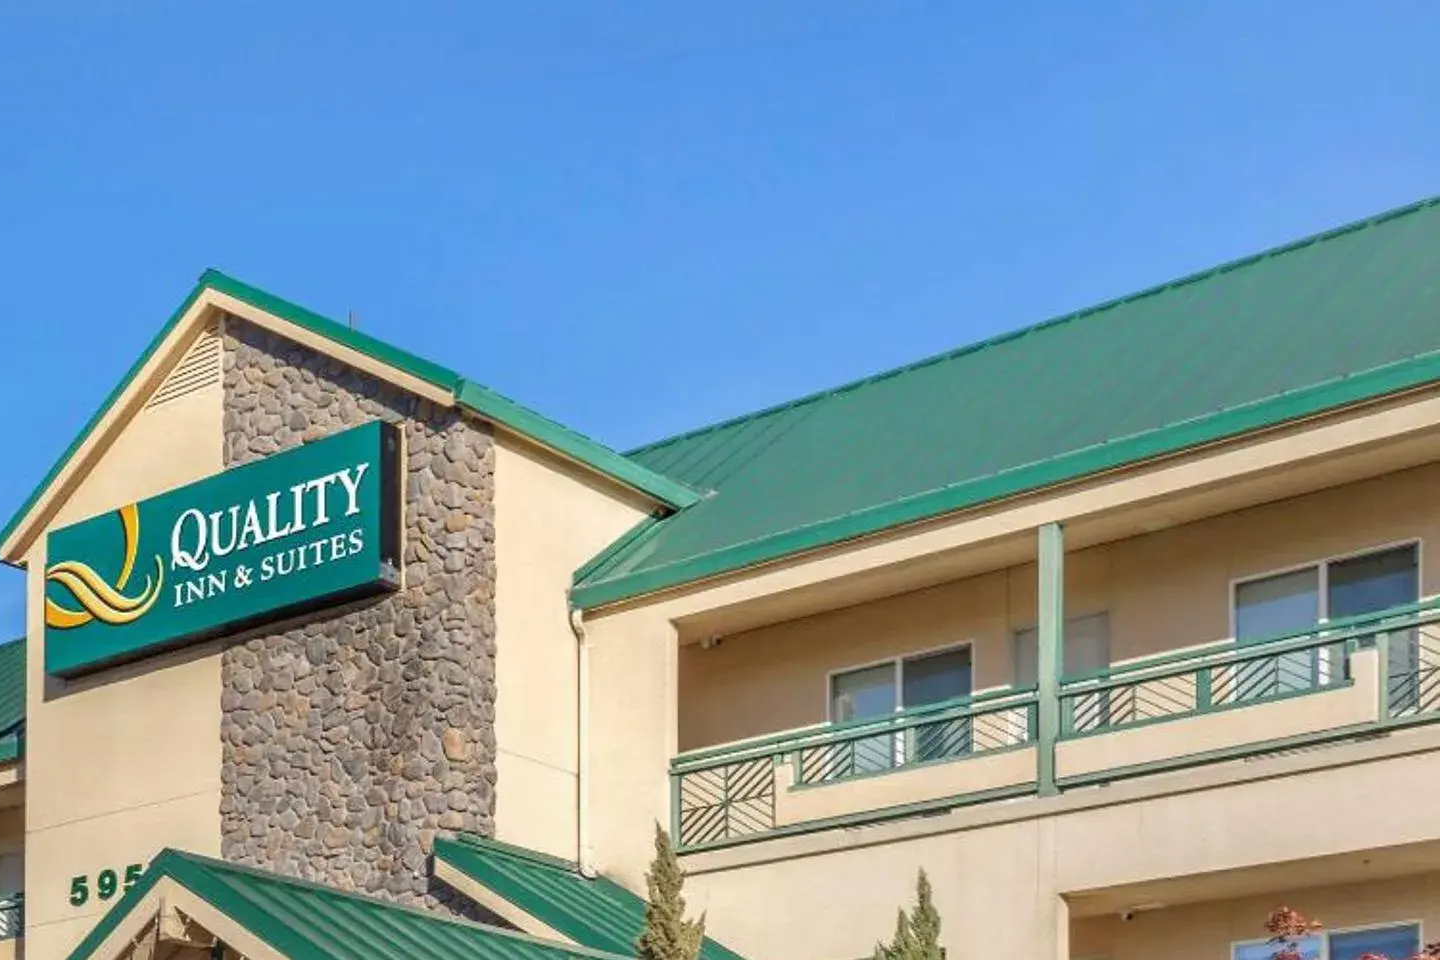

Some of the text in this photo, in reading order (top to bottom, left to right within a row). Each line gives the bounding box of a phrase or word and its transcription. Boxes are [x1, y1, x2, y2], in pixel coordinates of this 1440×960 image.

[171, 462, 369, 571] QUALITY
[173, 528, 364, 607] INN & SUITES
